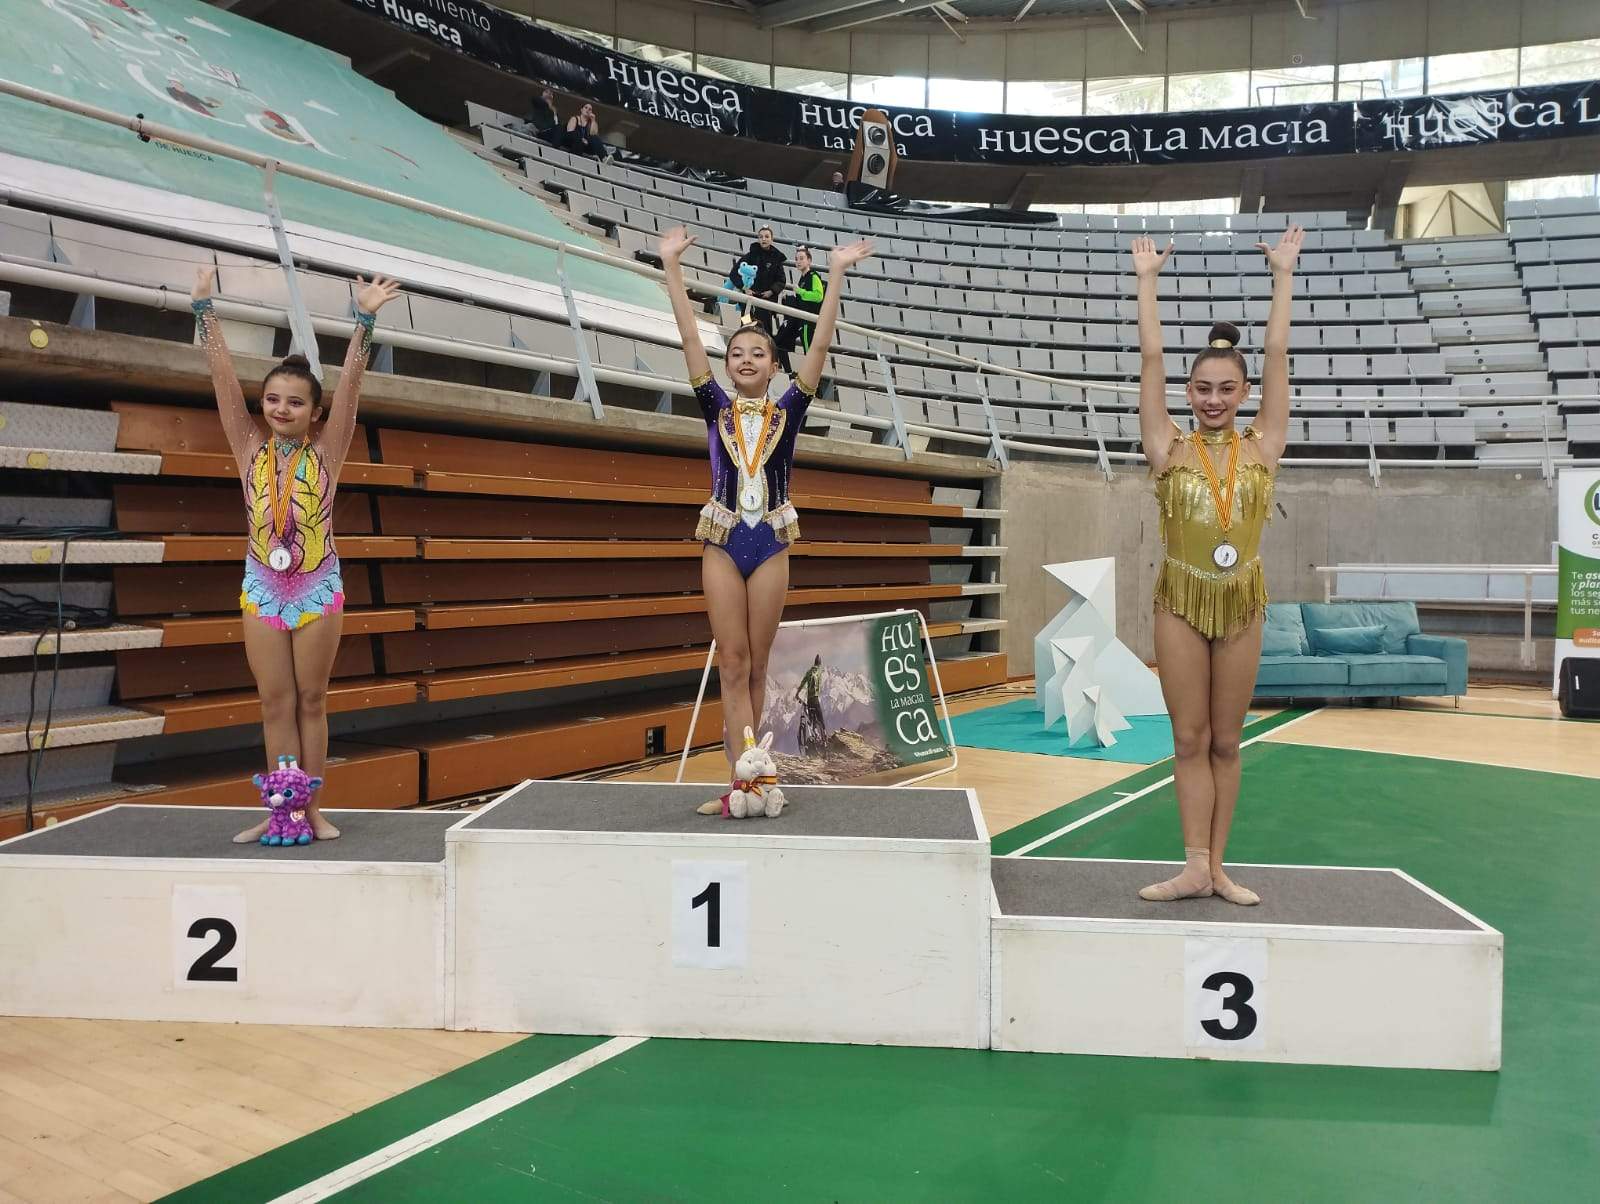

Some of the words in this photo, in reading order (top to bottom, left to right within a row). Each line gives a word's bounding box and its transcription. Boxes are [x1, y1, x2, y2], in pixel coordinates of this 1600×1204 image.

[383, 0, 463, 46] Huesca
[637, 98, 660, 116] La
[823, 135, 846, 150] La
[977, 125, 1133, 154] Huesca
[1143, 127, 1189, 152] La
[692, 882, 721, 947] 1
[186, 917, 238, 982] 2
[1200, 971, 1258, 1041] 3
